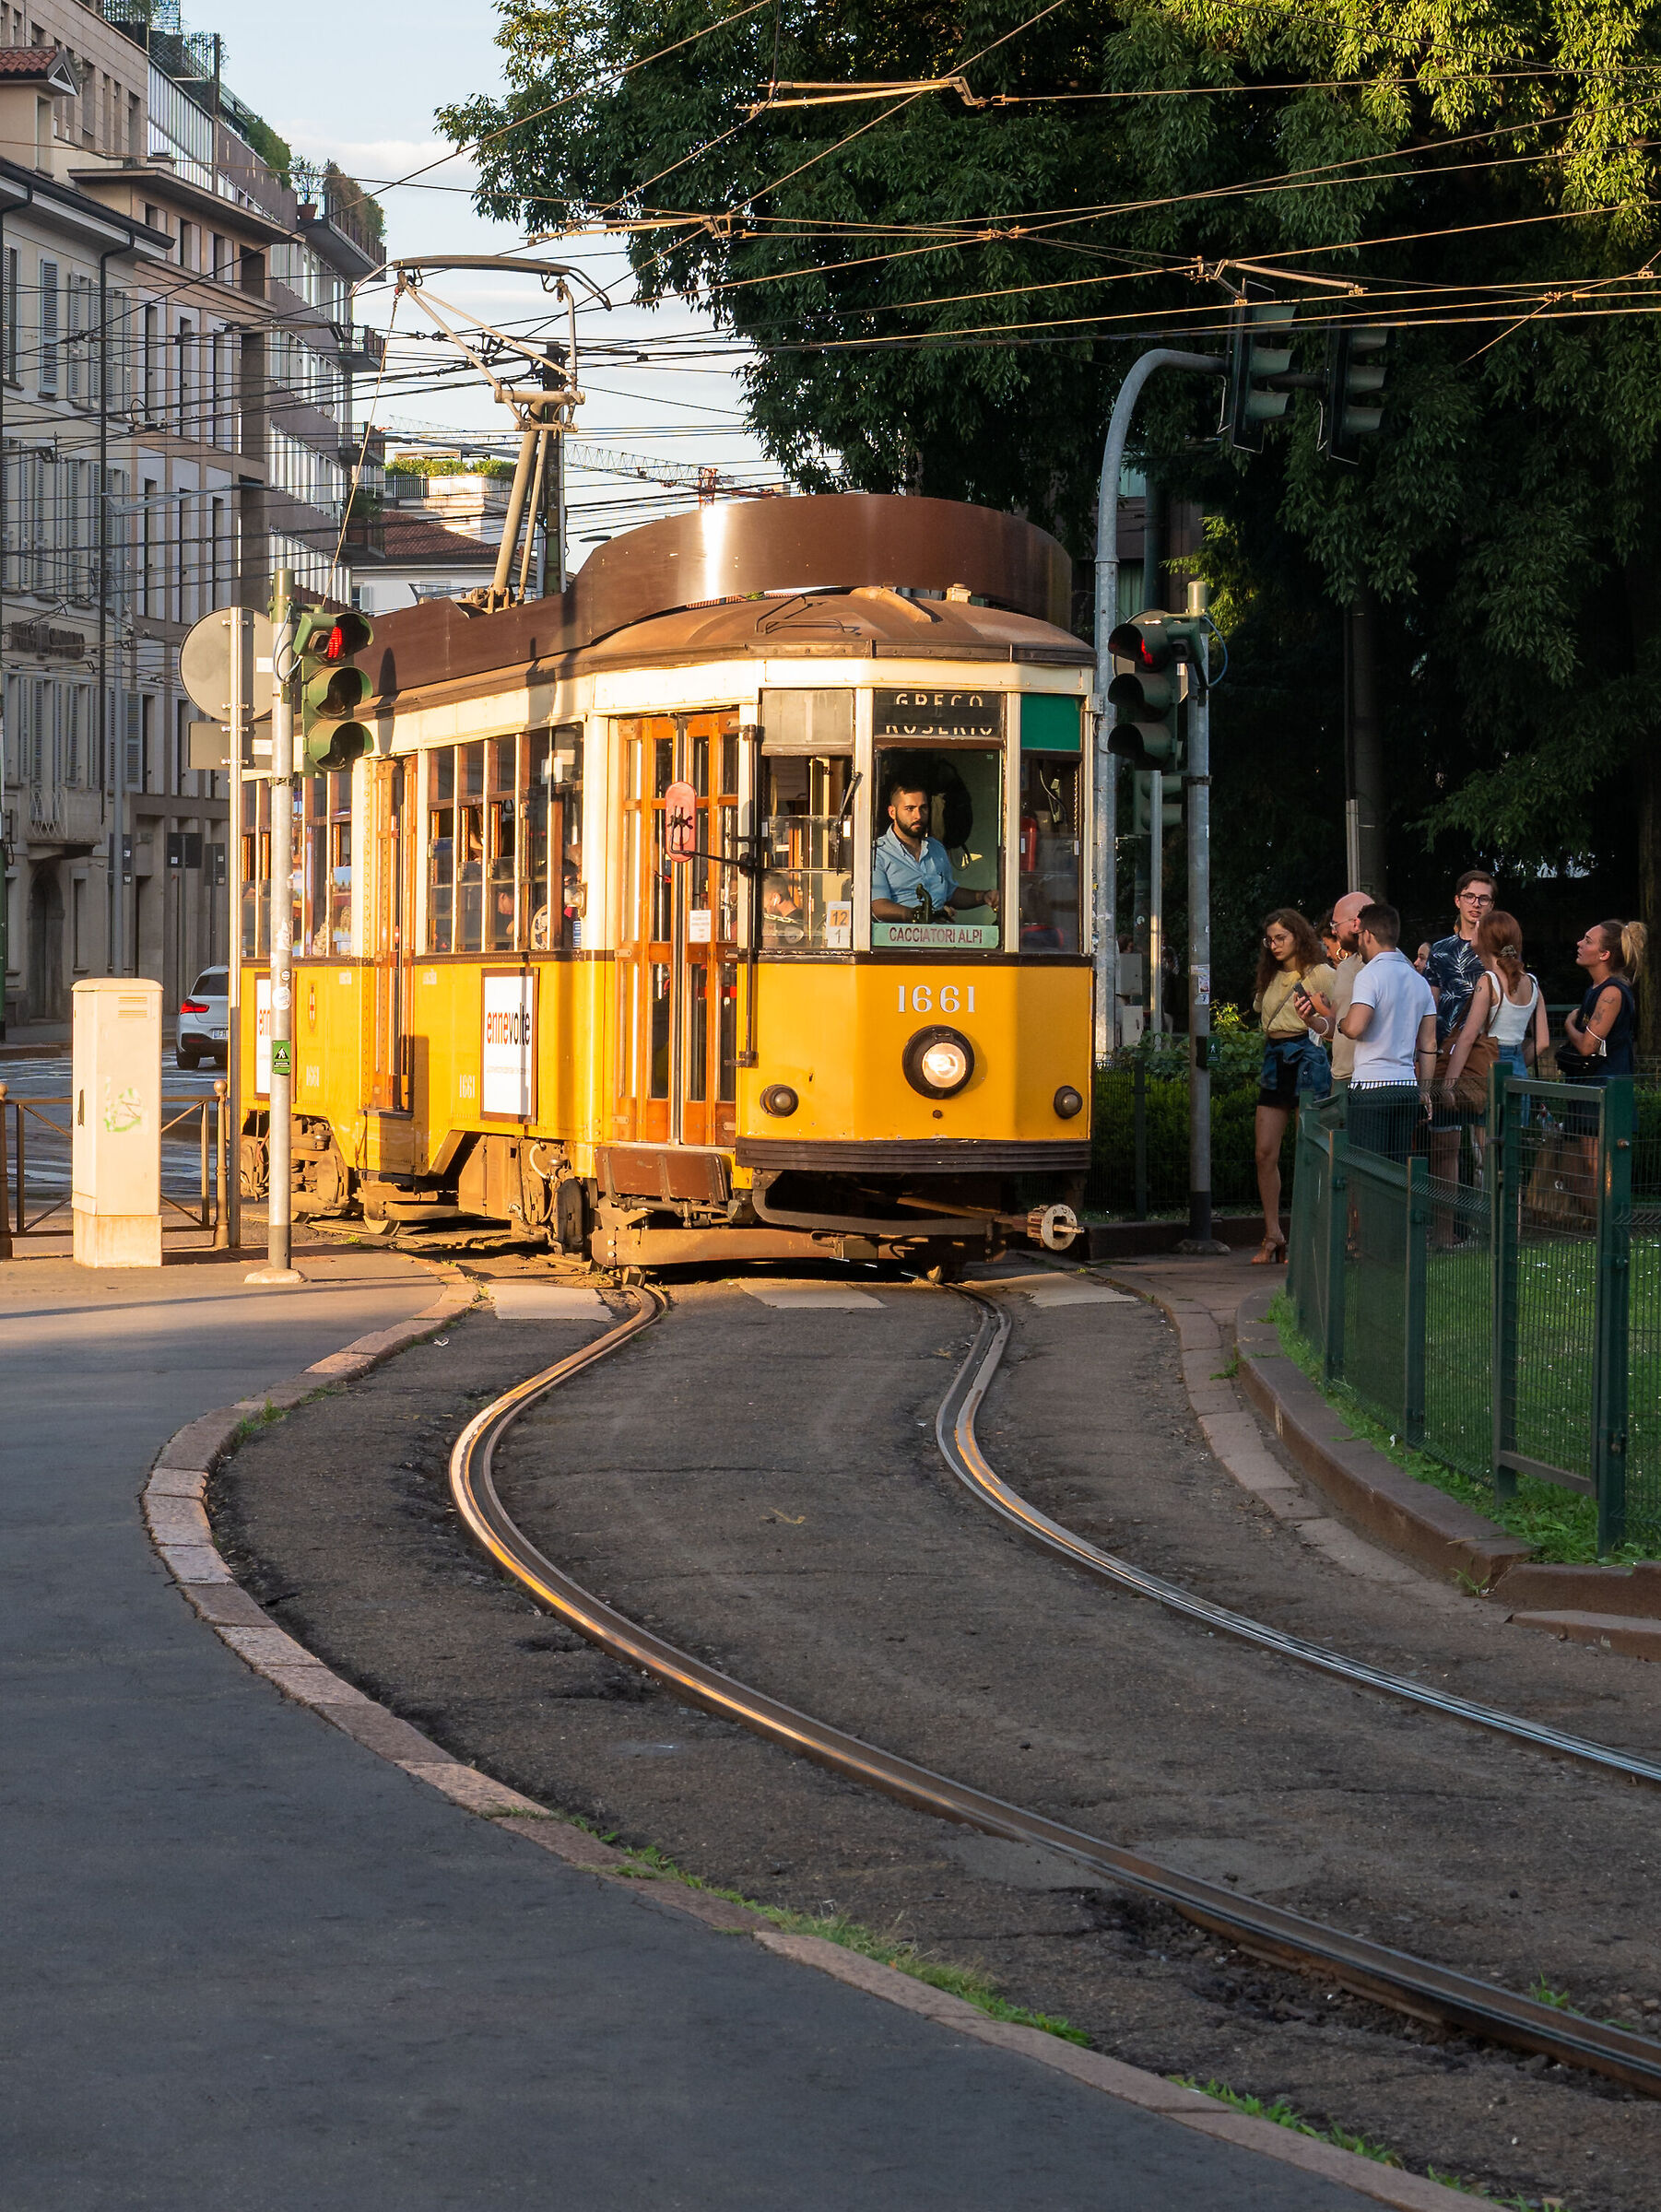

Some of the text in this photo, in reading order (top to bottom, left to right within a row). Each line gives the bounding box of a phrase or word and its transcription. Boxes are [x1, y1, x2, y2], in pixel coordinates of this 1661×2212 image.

[832, 911, 848, 926] 12
[889, 926, 983, 944] CACCIATORI ALPI
[898, 985, 975, 1013] 1661
[487, 1003, 531, 1046] ennevolte
[459, 1075, 476, 1099] 1661
